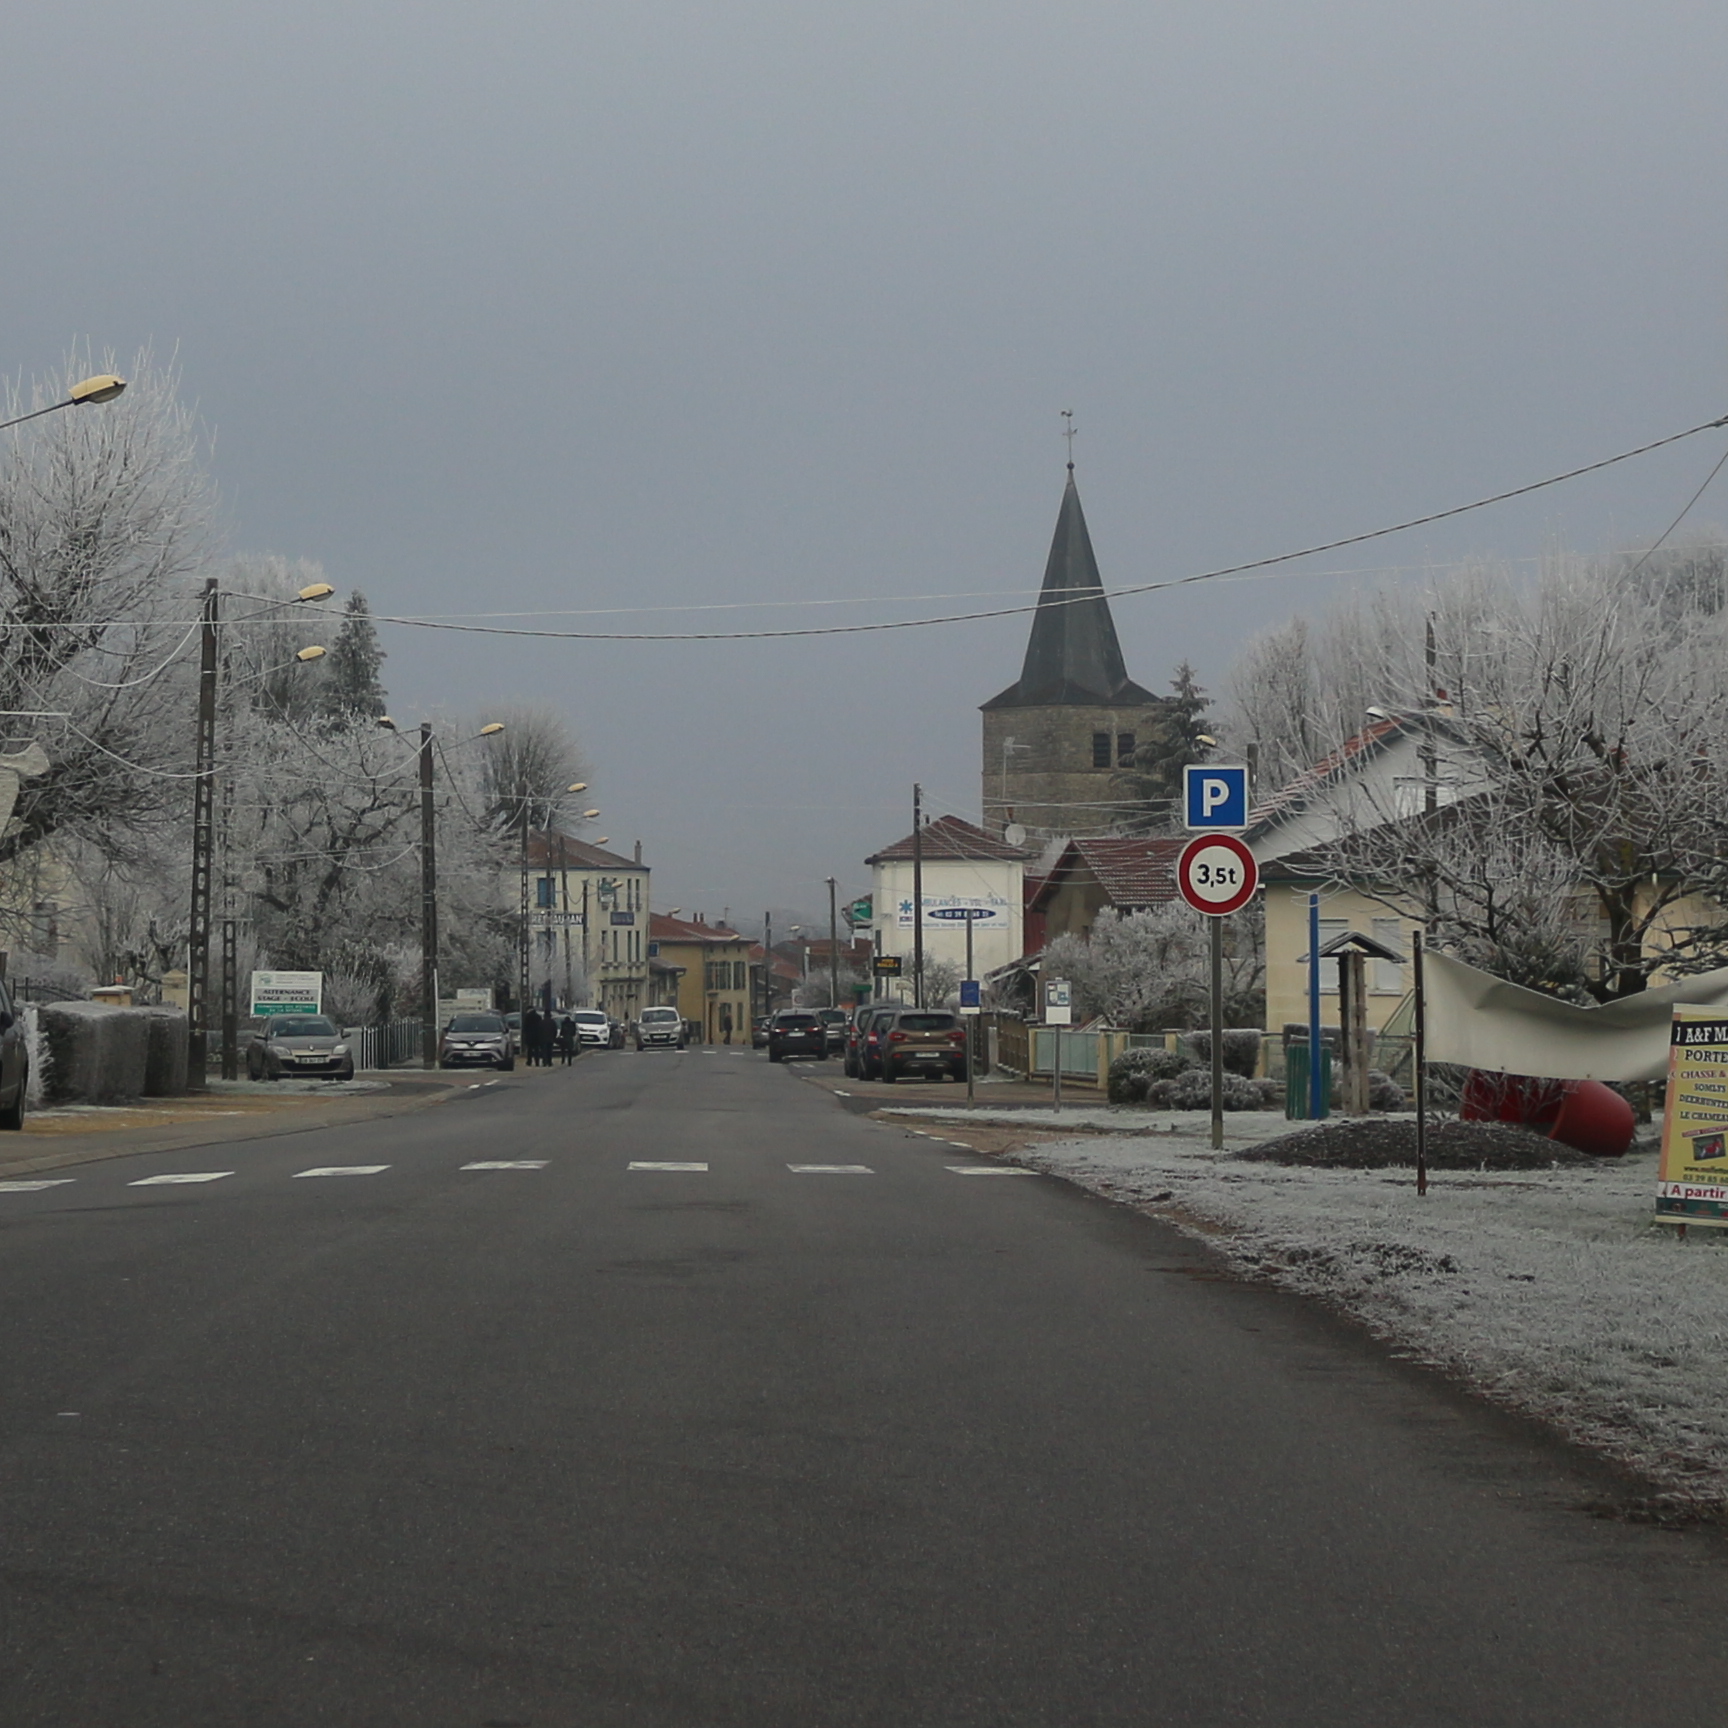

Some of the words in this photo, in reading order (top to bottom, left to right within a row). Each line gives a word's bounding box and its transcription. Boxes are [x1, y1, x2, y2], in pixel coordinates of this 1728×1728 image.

[1202, 778, 1230, 818] P
[1684, 1026, 1712, 1043] A&F
[1680, 1071, 1717, 1079] CHASSE
[1680, 1111, 1690, 1121] LE
[1671, 1185, 1681, 1196] A
[1685, 1186, 1725, 1200] partir
